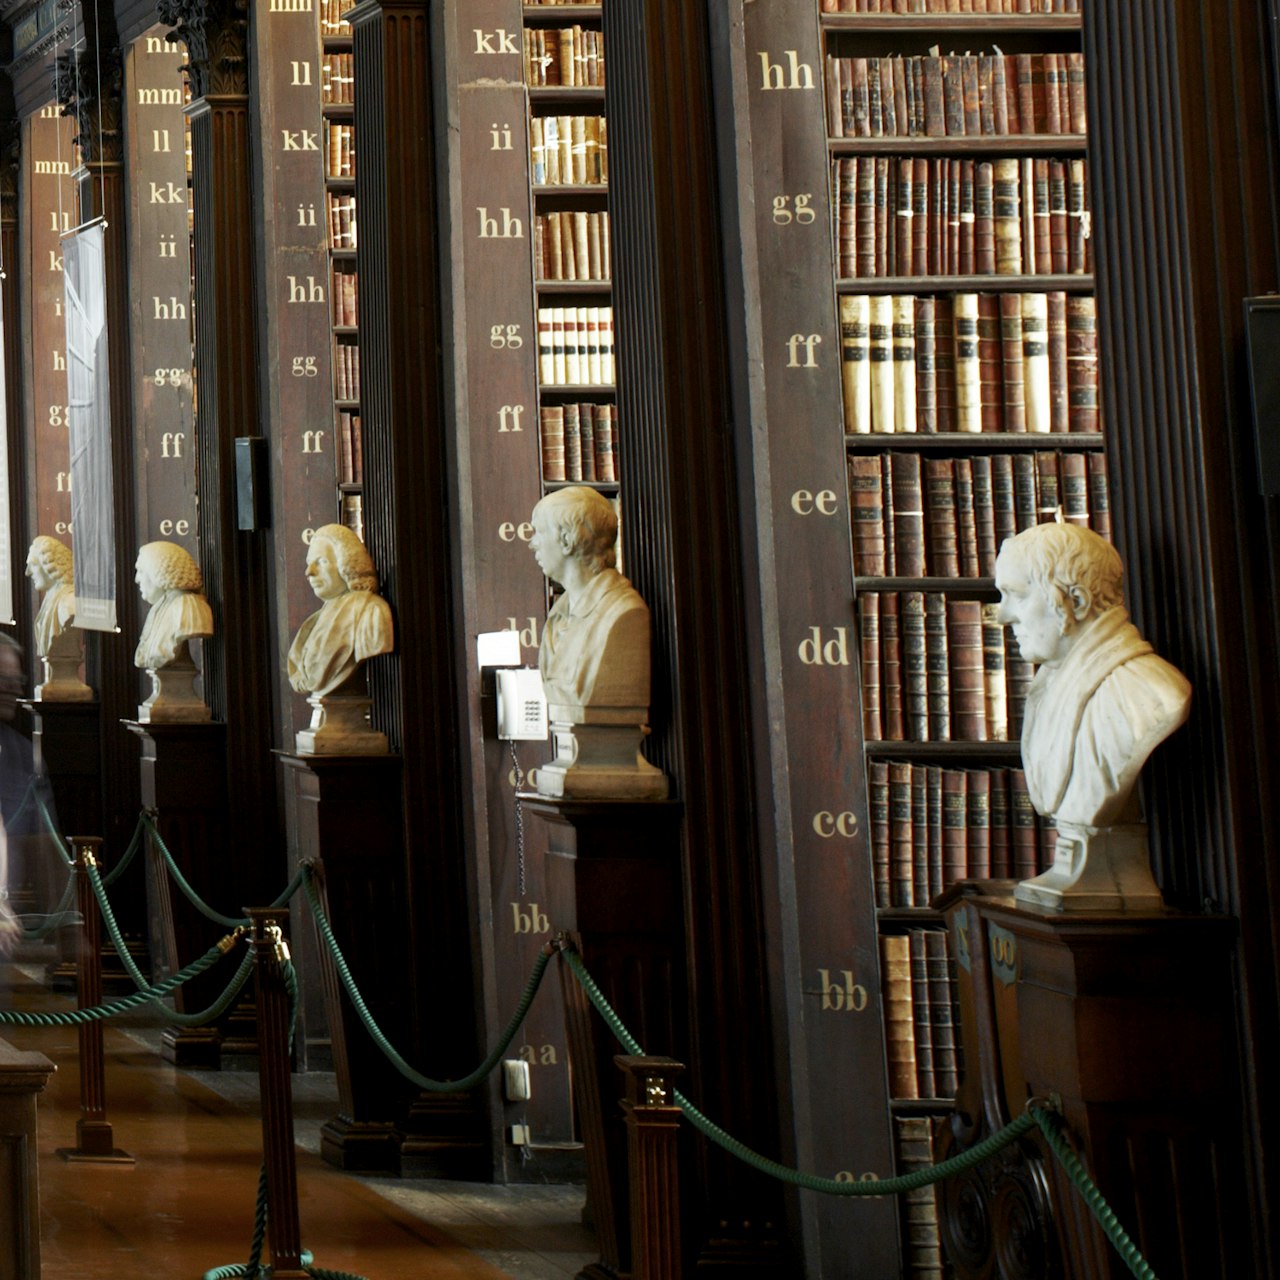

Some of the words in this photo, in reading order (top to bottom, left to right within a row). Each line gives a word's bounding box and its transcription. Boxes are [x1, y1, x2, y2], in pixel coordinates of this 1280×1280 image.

[473, 29, 520, 54] kk
[290, 61, 312, 86] ll
[757, 50, 816, 91] hh
[138, 88, 182, 105] mm
[153, 129, 171, 153] ll
[281, 129, 319, 151] kk
[489, 122, 514, 151] ii
[34, 160, 71, 175] mm
[149, 182, 184, 204] kk
[50, 211, 70, 232] ll
[297, 203, 317, 226] ii
[772, 193, 816, 225] gg
[476, 207, 524, 238] hh
[159, 234, 177, 258] ii
[286, 275, 325, 303] hh
[153, 296, 186, 320] hh
[490, 324, 523, 349] gg
[785, 333, 822, 368] ff
[154, 365, 184, 387] gg
[291, 354, 319, 377] gg
[497, 404, 524, 433] ff
[161, 432, 185, 458] ff
[302, 430, 324, 454] ff
[791, 489, 838, 516] ee
[159, 519, 189, 536] ee
[498, 521, 535, 542] ee
[798, 626, 850, 666] dd
[812, 810, 859, 838] cc
[510, 902, 550, 934] bb
[818, 968, 868, 1012] bb
